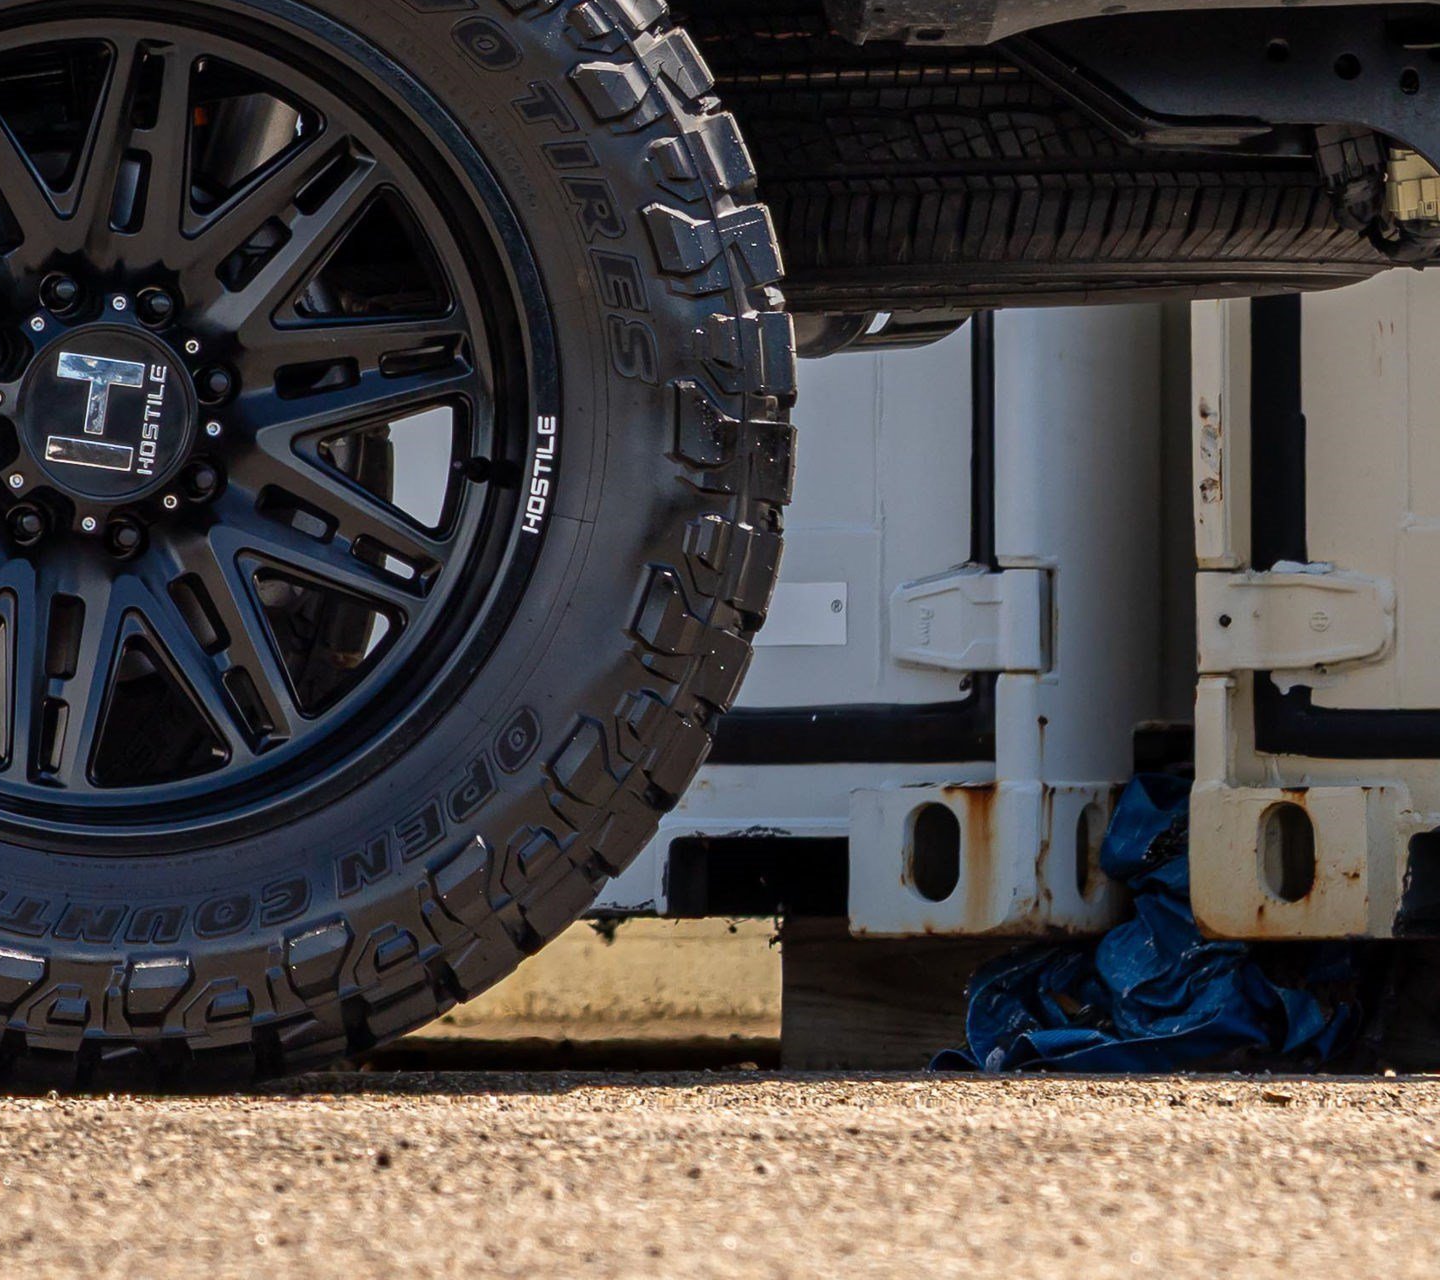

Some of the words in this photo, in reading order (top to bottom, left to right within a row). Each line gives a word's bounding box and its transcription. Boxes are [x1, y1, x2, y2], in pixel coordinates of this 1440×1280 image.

[511, 80, 658, 385] TIRES
[136, 364, 167, 475] HOSTILE
[522, 415, 556, 534] HOSTILE
[334, 705, 542, 900] OPEN
